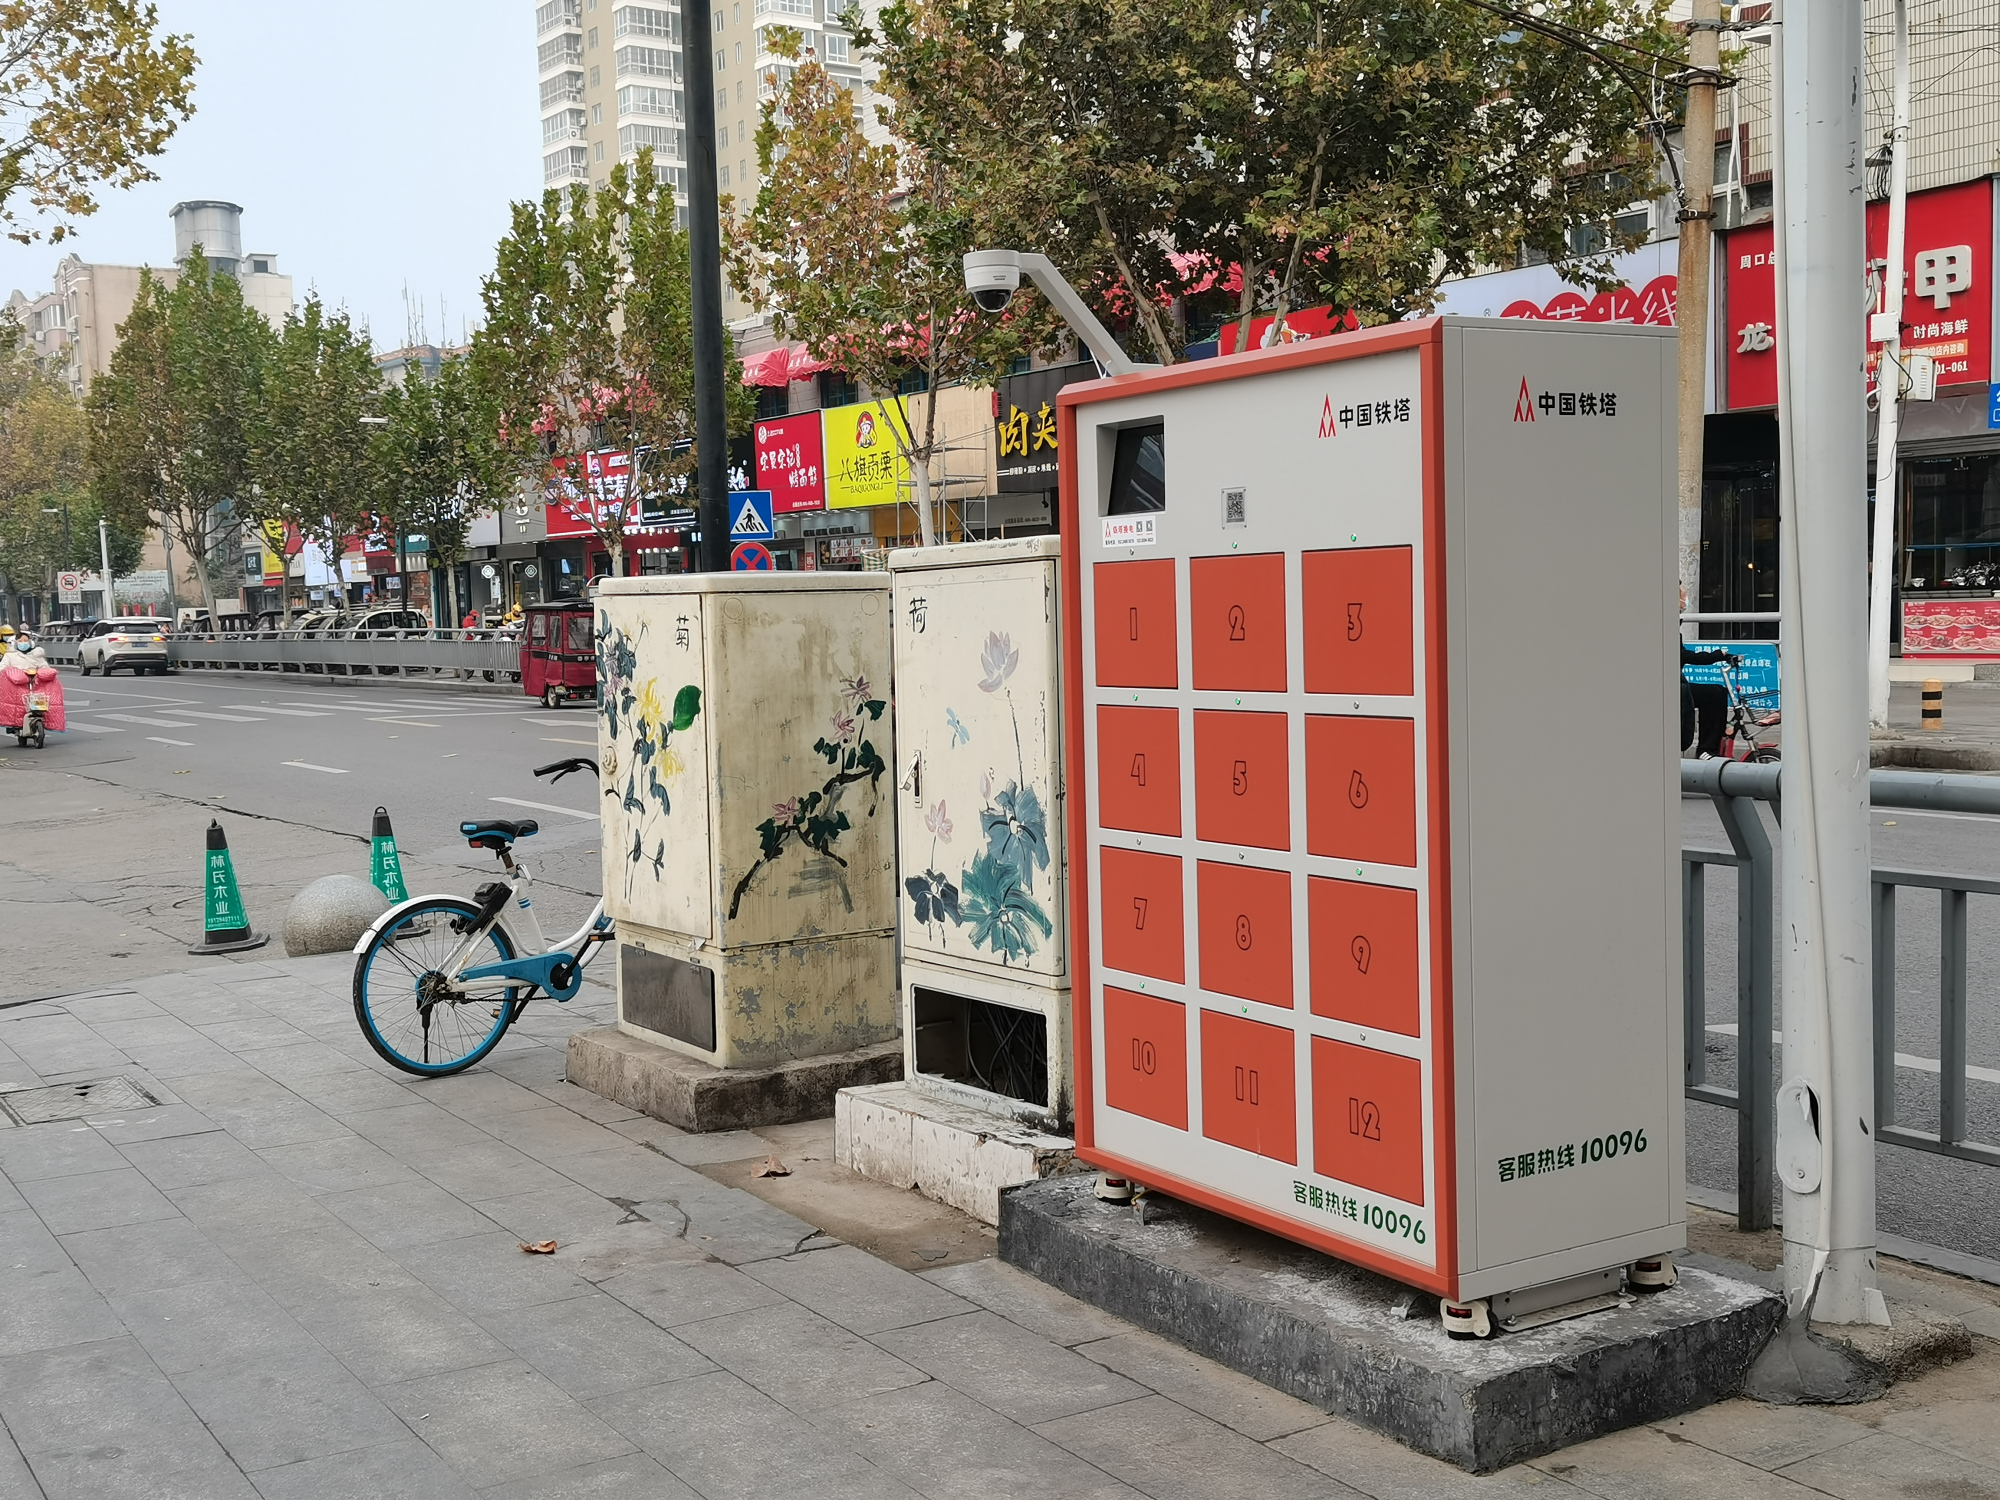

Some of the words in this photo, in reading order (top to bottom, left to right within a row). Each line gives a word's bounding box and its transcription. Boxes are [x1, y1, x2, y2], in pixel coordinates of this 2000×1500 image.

[1737, 322, 1775, 354] 龙
[1913, 319, 1968, 339] 时尚海鲜
[1922, 342, 1965, 357] 的店内咨询
[1339, 397, 1411, 430] 中国铁塔
[1538, 391, 1617, 416] 中国铁塔
[999, 401, 1059, 457] 肉夹
[840, 451, 893, 482] 八旗贡栗
[909, 596, 928, 634] 荷
[1130, 607, 1137, 641] 1
[1228, 605, 1245, 641] 2
[1347, 603, 1363, 641] 3
[676, 614, 689, 653] 菊
[1131, 754, 1145, 786] 4
[1233, 760, 1248, 796] 5
[1349, 770, 1368, 809] 6
[210, 854, 230, 915] 林氏木业
[1134, 897, 1148, 930] 7
[1235, 914, 1252, 951] 8
[1351, 935, 1371, 975] 9
[1132, 1037, 1156, 1075] 10
[1235, 1066, 1258, 1106] 11
[1349, 1097, 1380, 1141] 12
[1580, 1128, 1648, 1164] 10096
[1362, 1203, 1426, 1245] 10096
